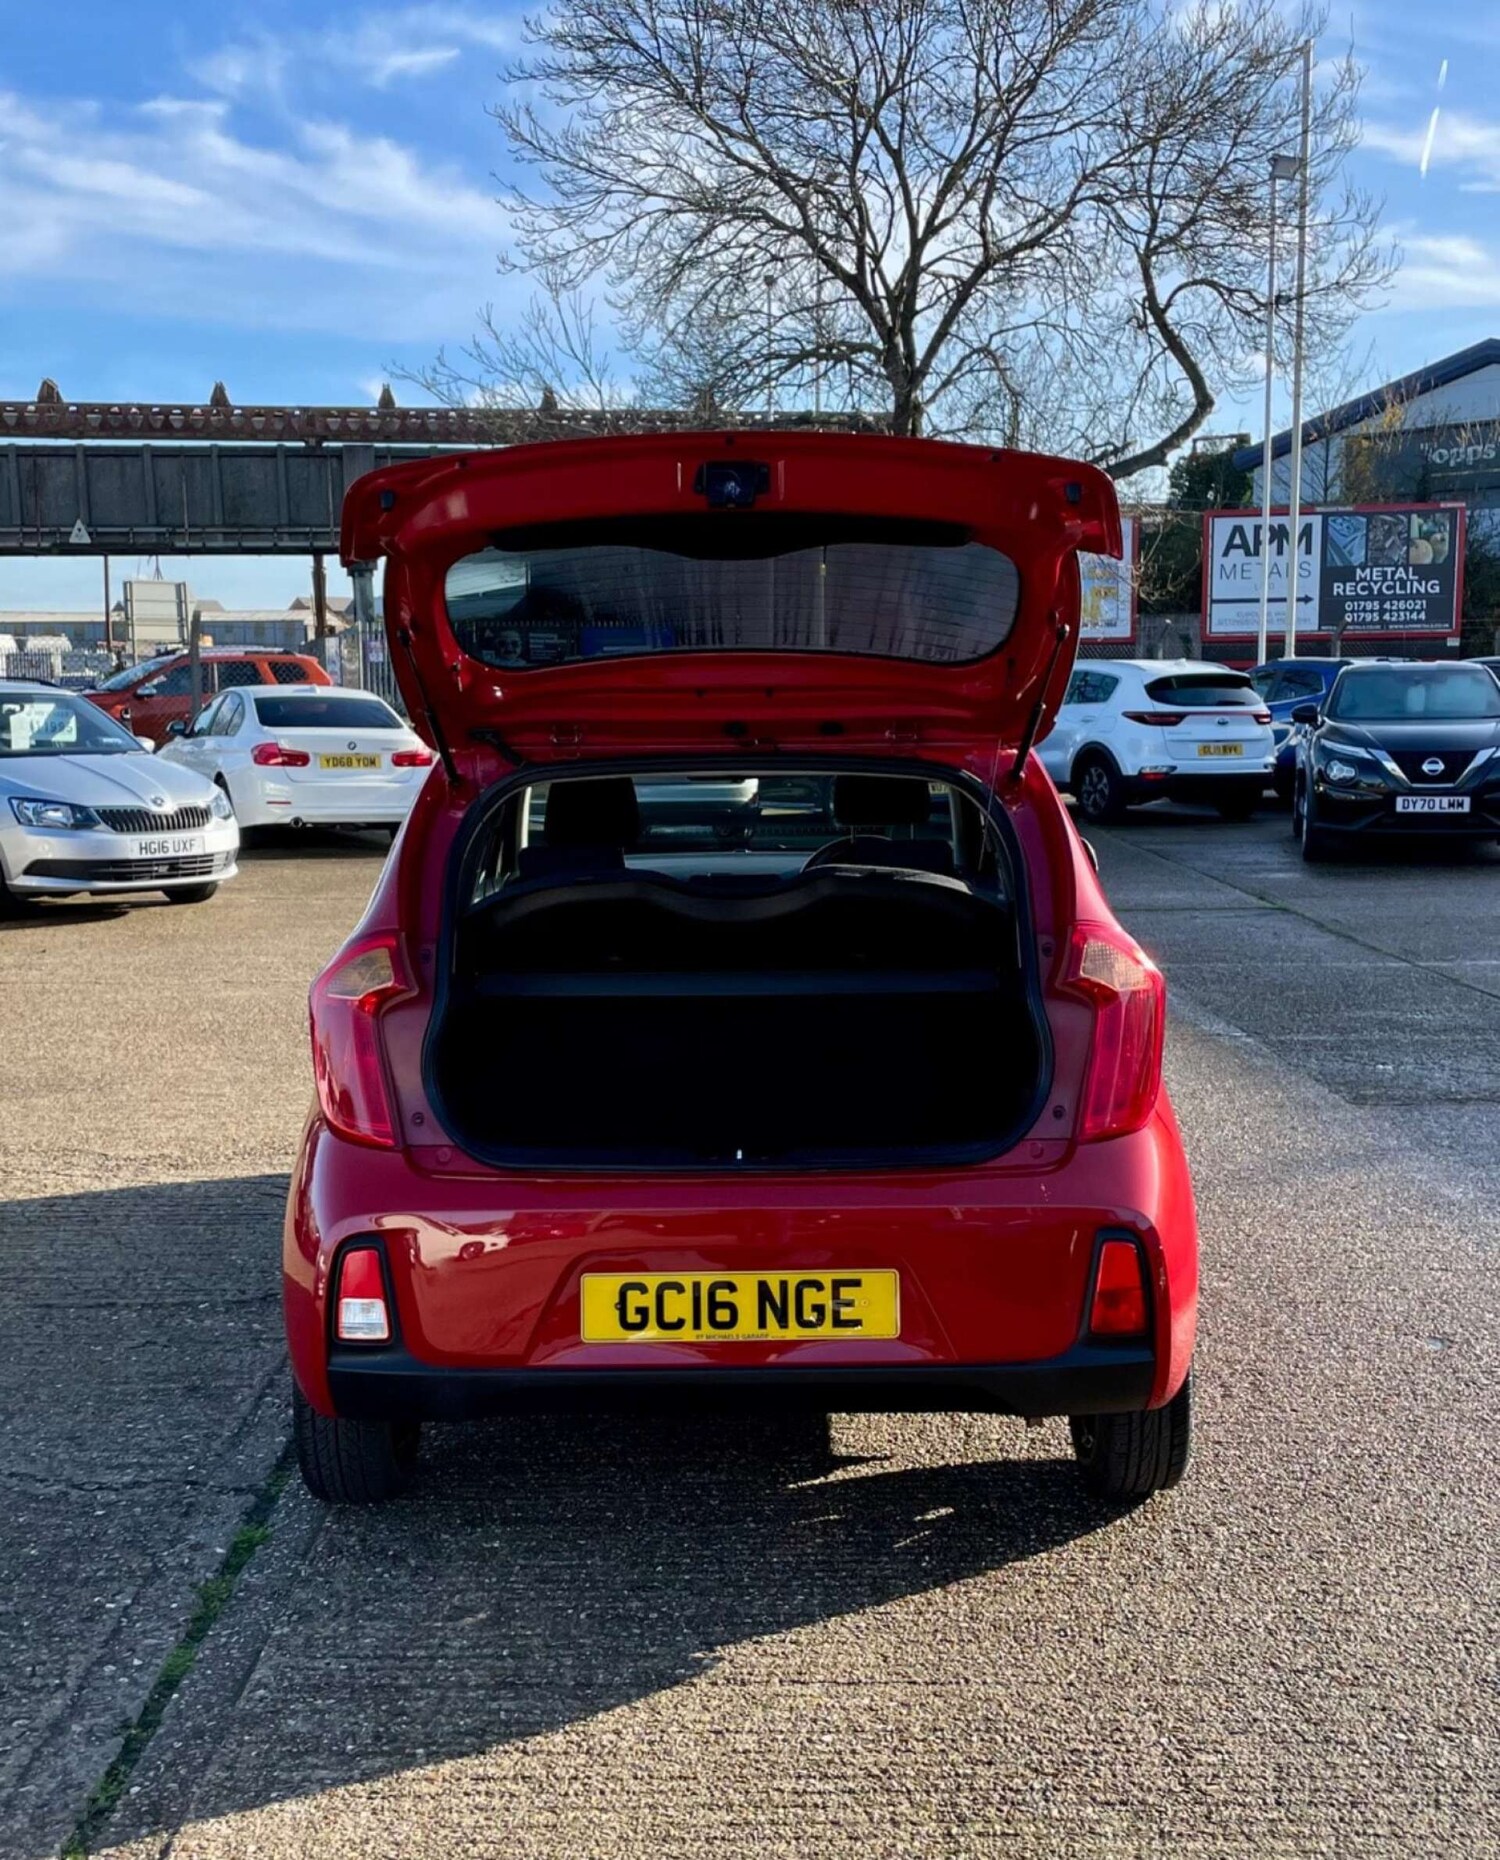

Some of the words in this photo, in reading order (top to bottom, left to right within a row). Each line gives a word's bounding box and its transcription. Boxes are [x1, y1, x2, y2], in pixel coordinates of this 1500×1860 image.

[1221, 522, 1313, 558] APM
[1356, 567, 1419, 581] METAL
[1333, 580, 1440, 596] RECYCLING
[1345, 601, 1380, 612] 01795
[1383, 600, 1426, 610] 426021
[1344, 612, 1380, 623] 01795
[1382, 611, 1426, 621] 423144
[1402, 798, 1435, 810] DY70
[139, 840, 170, 855] HG16
[172, 838, 196, 853] UXF
[617, 1281, 738, 1331] GC16
[757, 1278, 863, 1330] NGE
